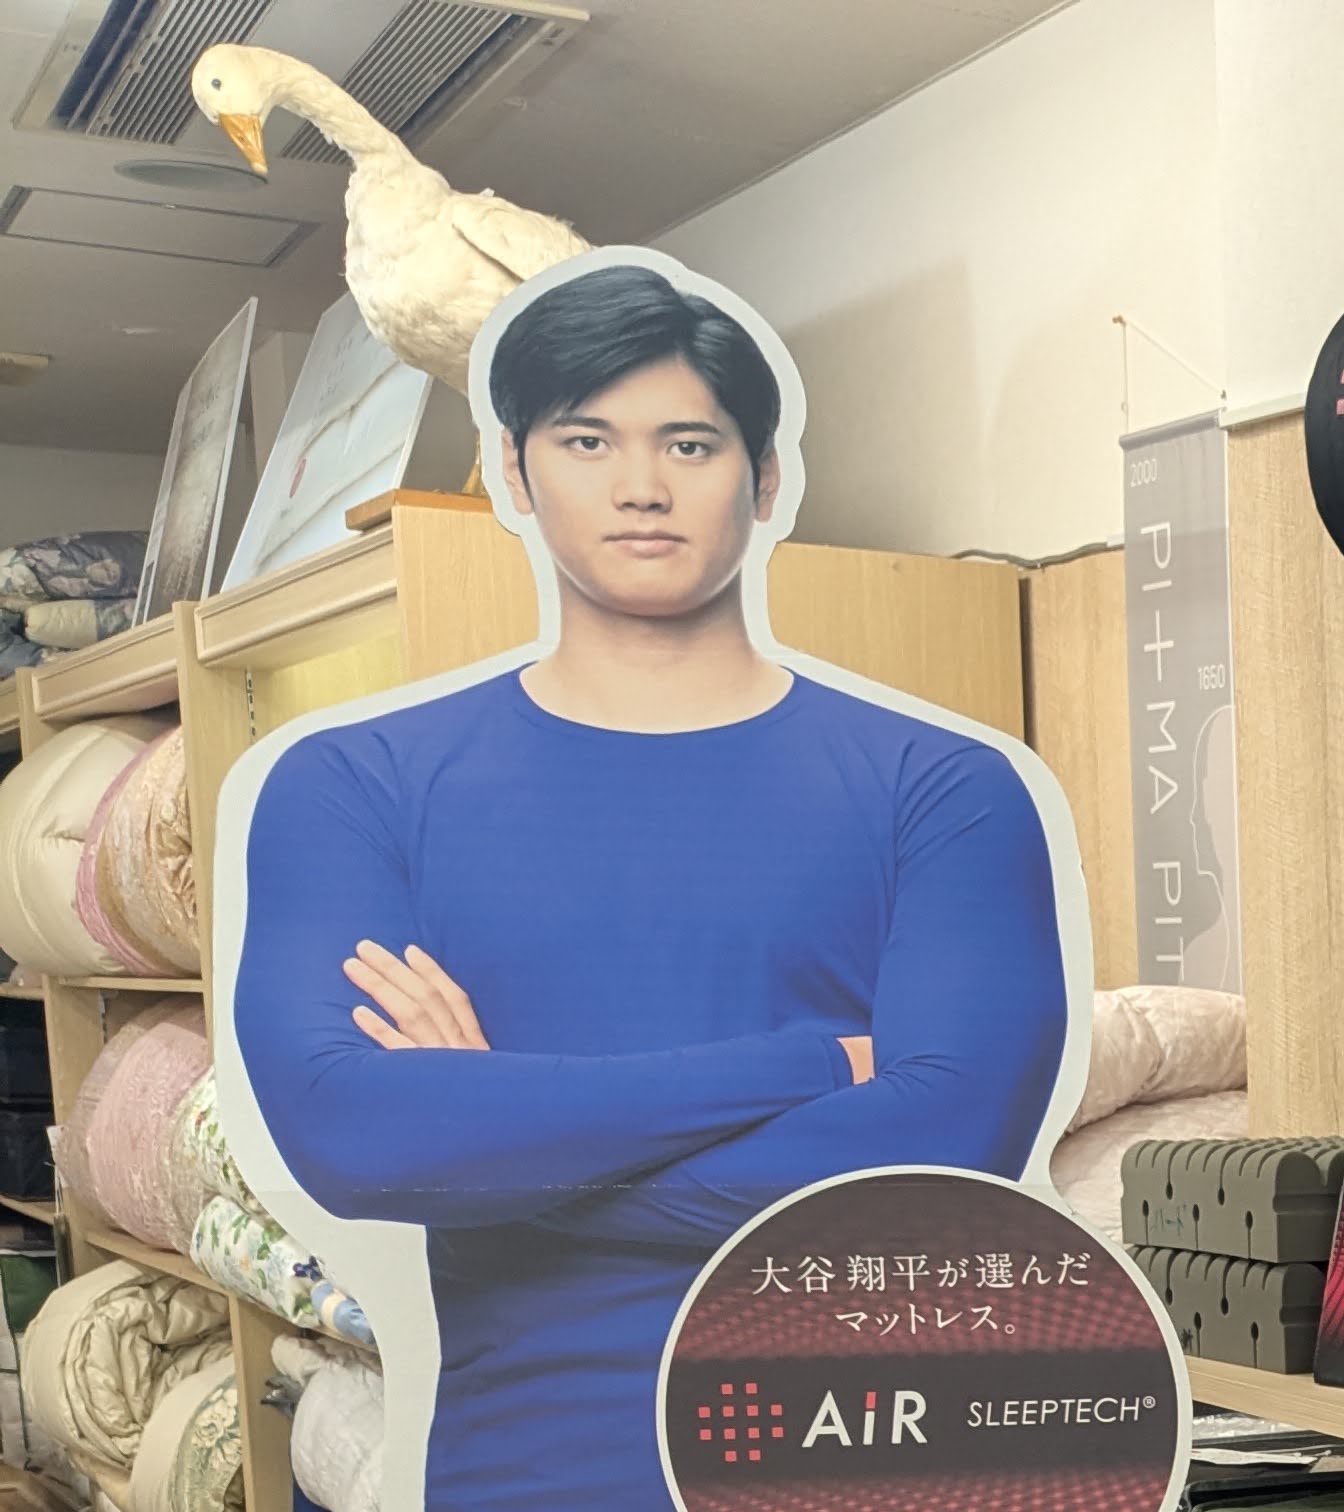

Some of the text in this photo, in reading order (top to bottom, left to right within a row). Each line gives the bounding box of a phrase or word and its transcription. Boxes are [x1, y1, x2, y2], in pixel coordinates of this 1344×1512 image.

[1197, 664, 1226, 690] 1650
[834, 1304, 1017, 1337] マットレス。
